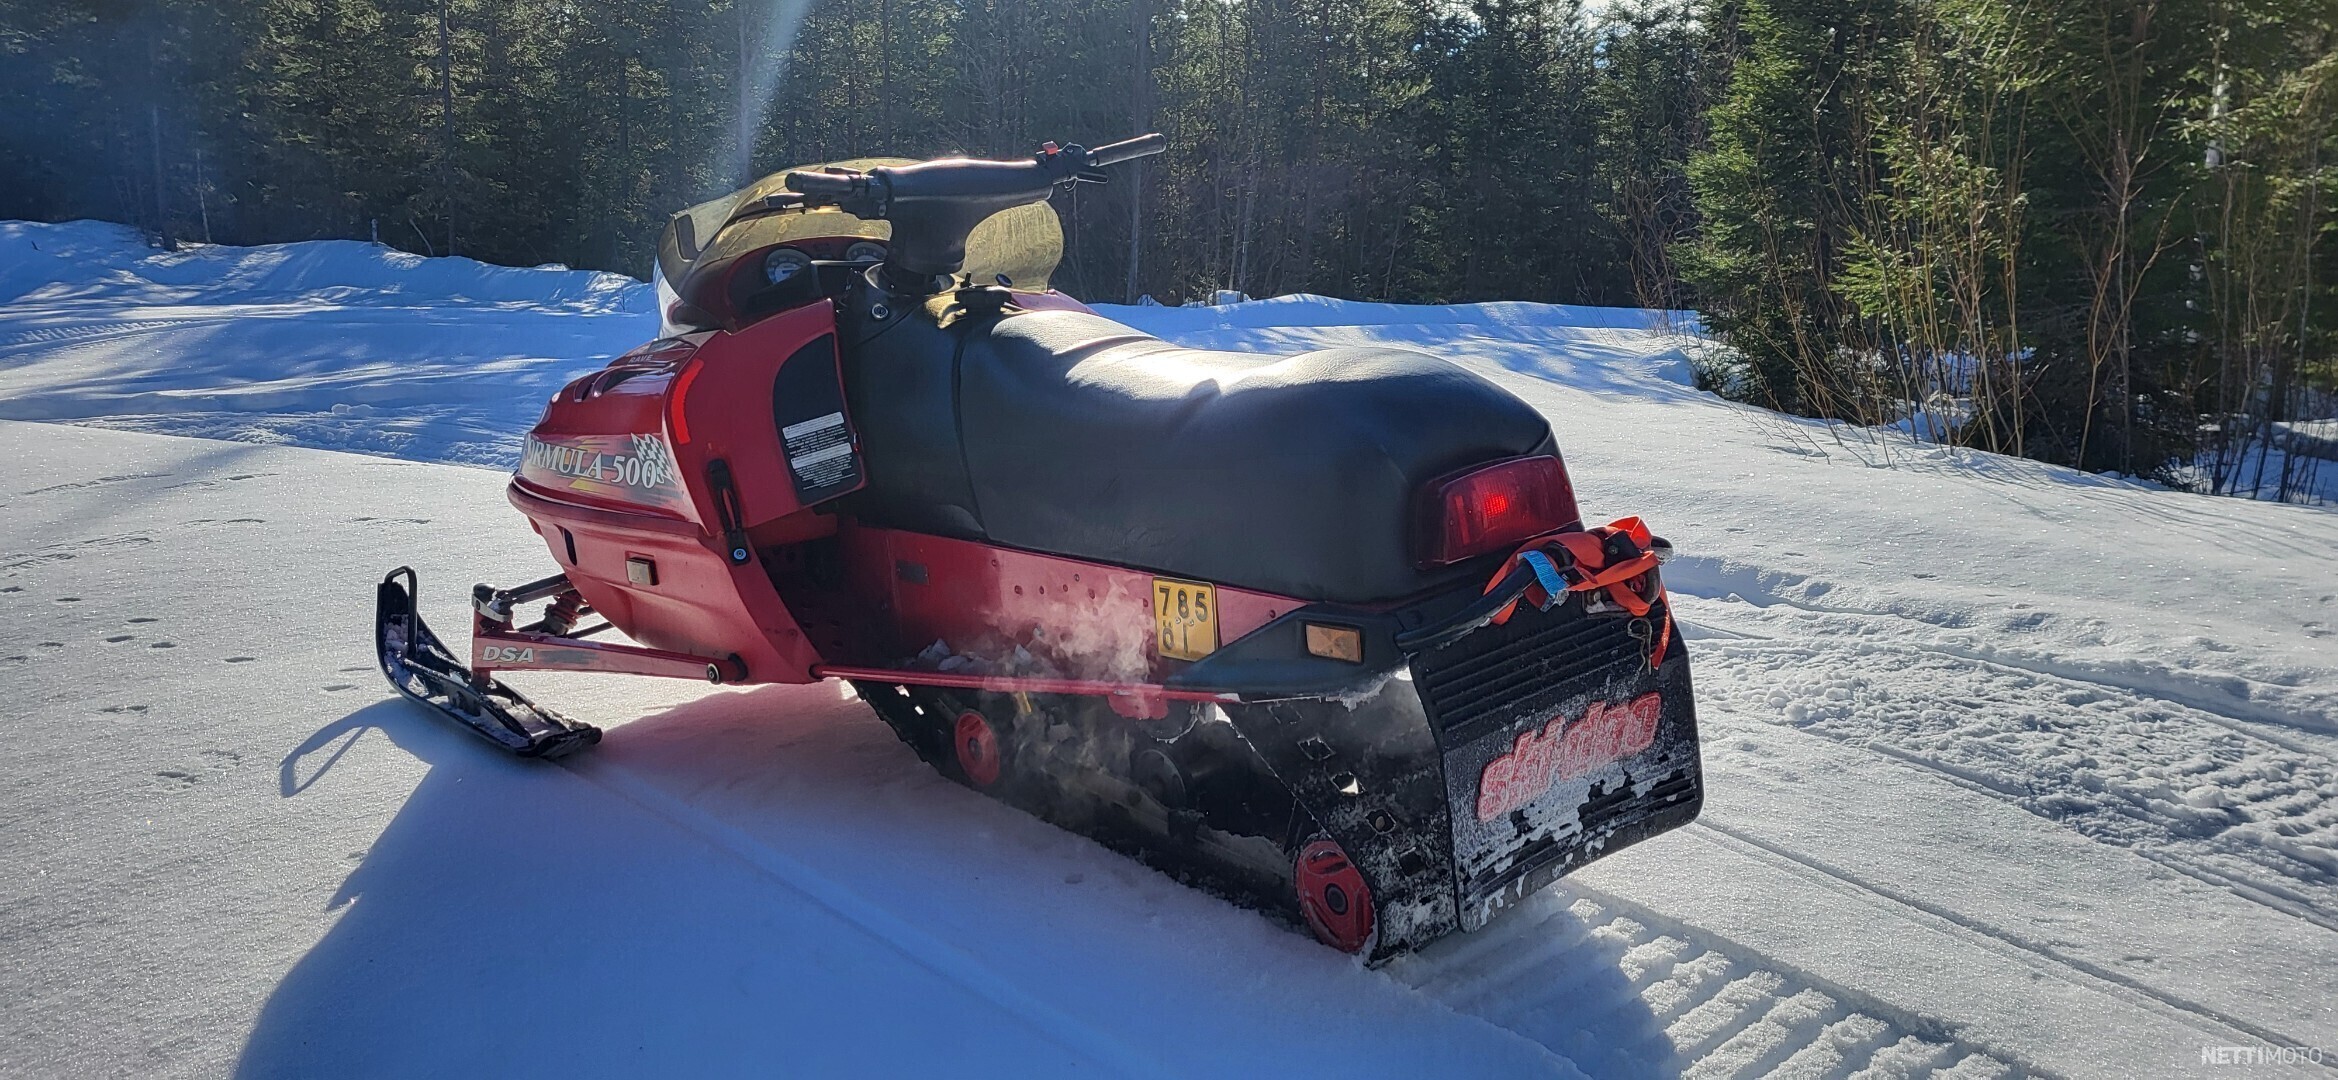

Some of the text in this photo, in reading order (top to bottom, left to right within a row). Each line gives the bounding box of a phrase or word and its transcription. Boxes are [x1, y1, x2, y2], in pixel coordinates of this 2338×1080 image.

[524, 436, 656, 490] ORMULA 500
[1159, 587, 1208, 622] 785
[482, 646, 534, 662] DSA
